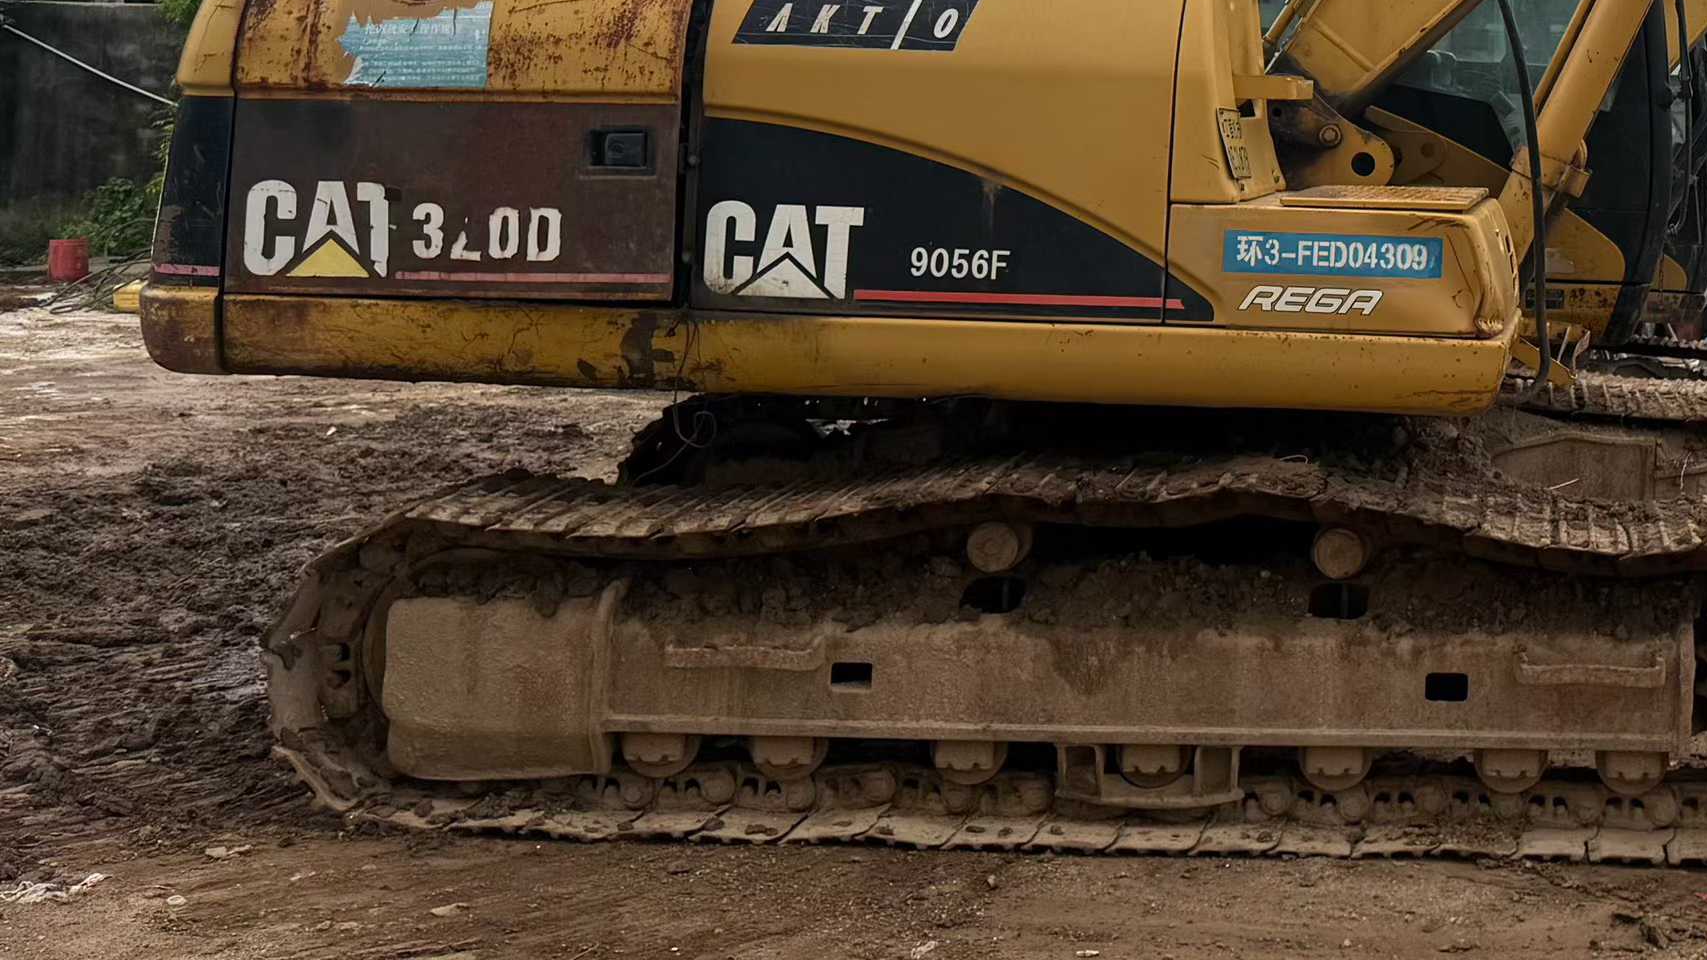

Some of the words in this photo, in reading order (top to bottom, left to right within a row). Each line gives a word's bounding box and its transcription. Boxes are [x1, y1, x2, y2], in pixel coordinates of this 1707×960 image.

[243, 178, 389, 278] CAT
[702, 200, 865, 300] CAT
[910, 246, 1011, 281] 9056F
[1236, 235, 1428, 271] 环3-FED04309
[1238, 284, 1384, 316] REGA
